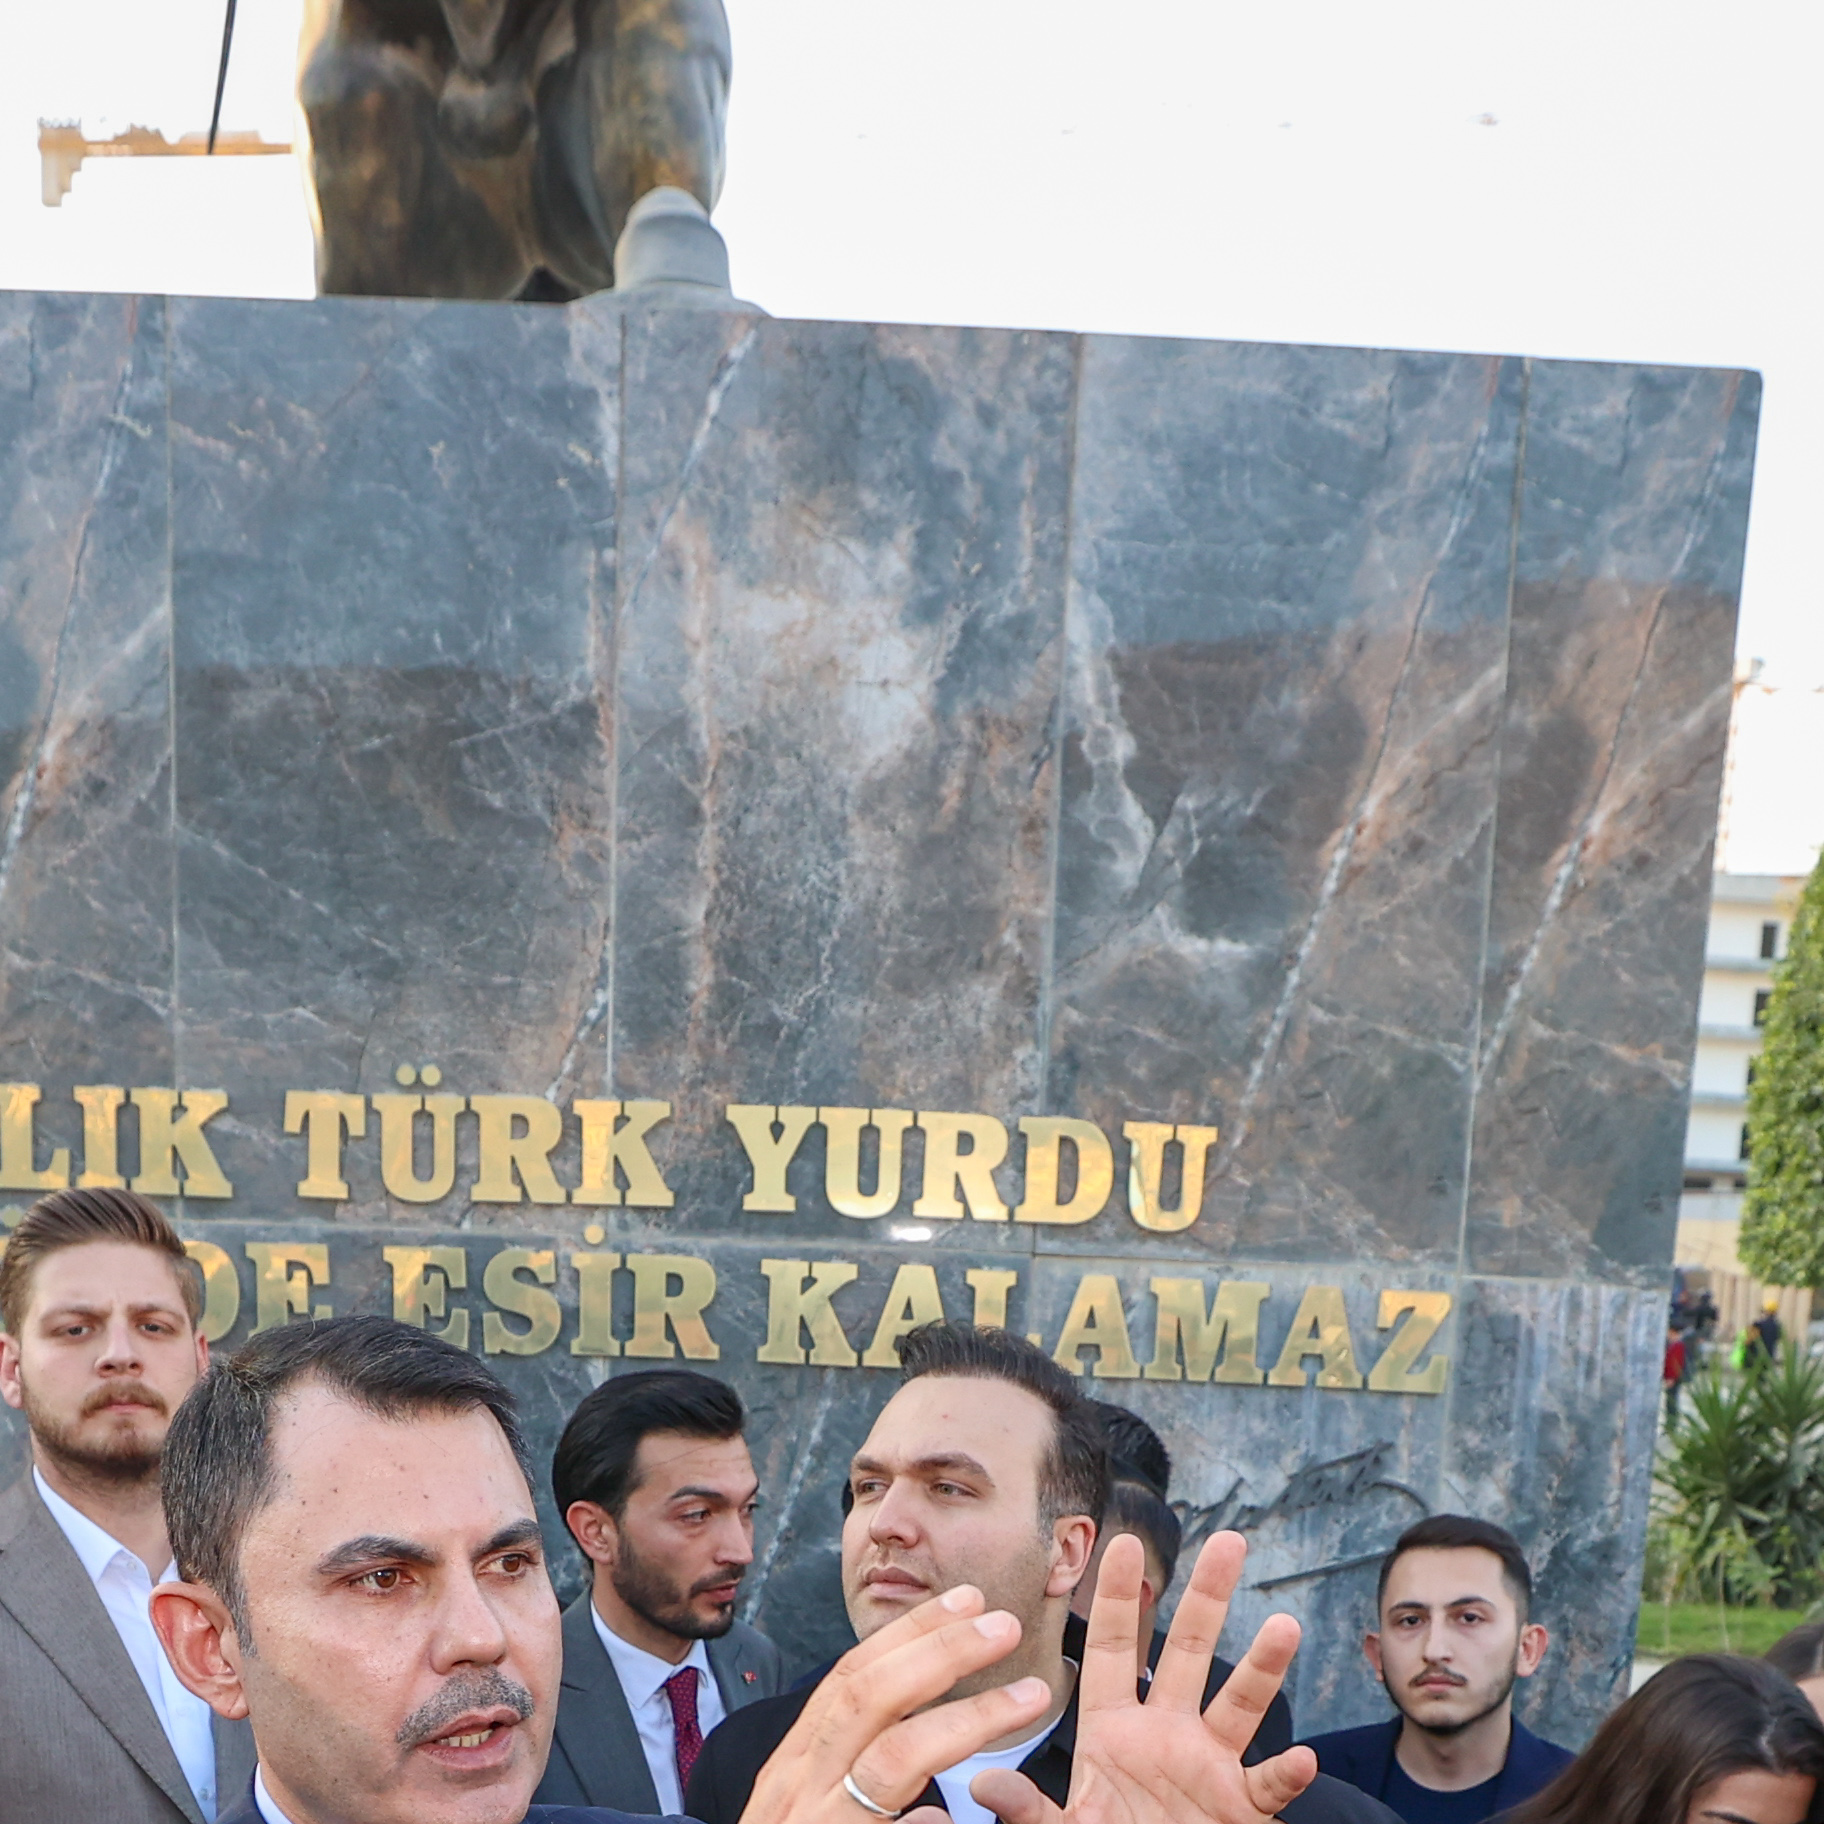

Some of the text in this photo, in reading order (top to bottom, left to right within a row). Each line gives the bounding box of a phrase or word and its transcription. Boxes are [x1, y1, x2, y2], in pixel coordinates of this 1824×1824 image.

[281, 1062, 676, 1208] TÜRK
[724, 1103, 1219, 1234] YURDU
[382, 1224, 721, 1361] ESİR
